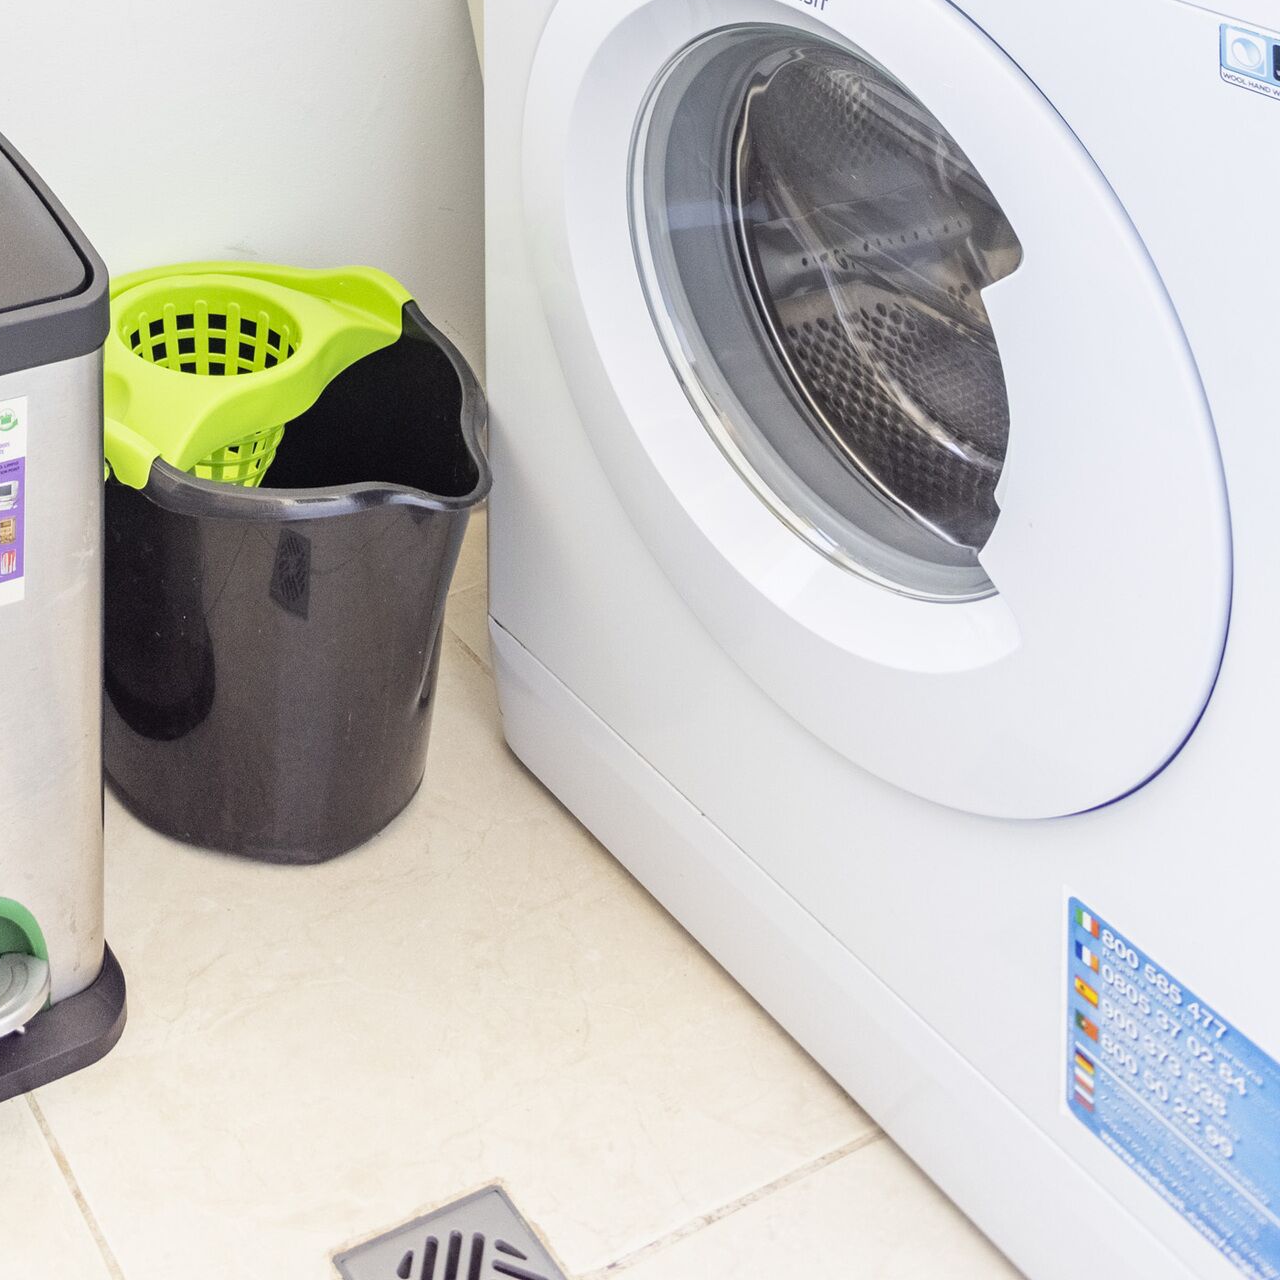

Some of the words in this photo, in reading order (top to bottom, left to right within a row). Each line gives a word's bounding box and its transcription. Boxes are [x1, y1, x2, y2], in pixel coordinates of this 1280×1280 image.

[1223, 72, 1247, 85] WOOL
[1248, 81, 1271, 93] HAND
[1102, 929, 1139, 969] 800
[1145, 963, 1183, 1005] 585
[1187, 1002, 1228, 1039] 477
[1102, 964, 1151, 1015] 0805
[1186, 1036, 1215, 1064] 02
